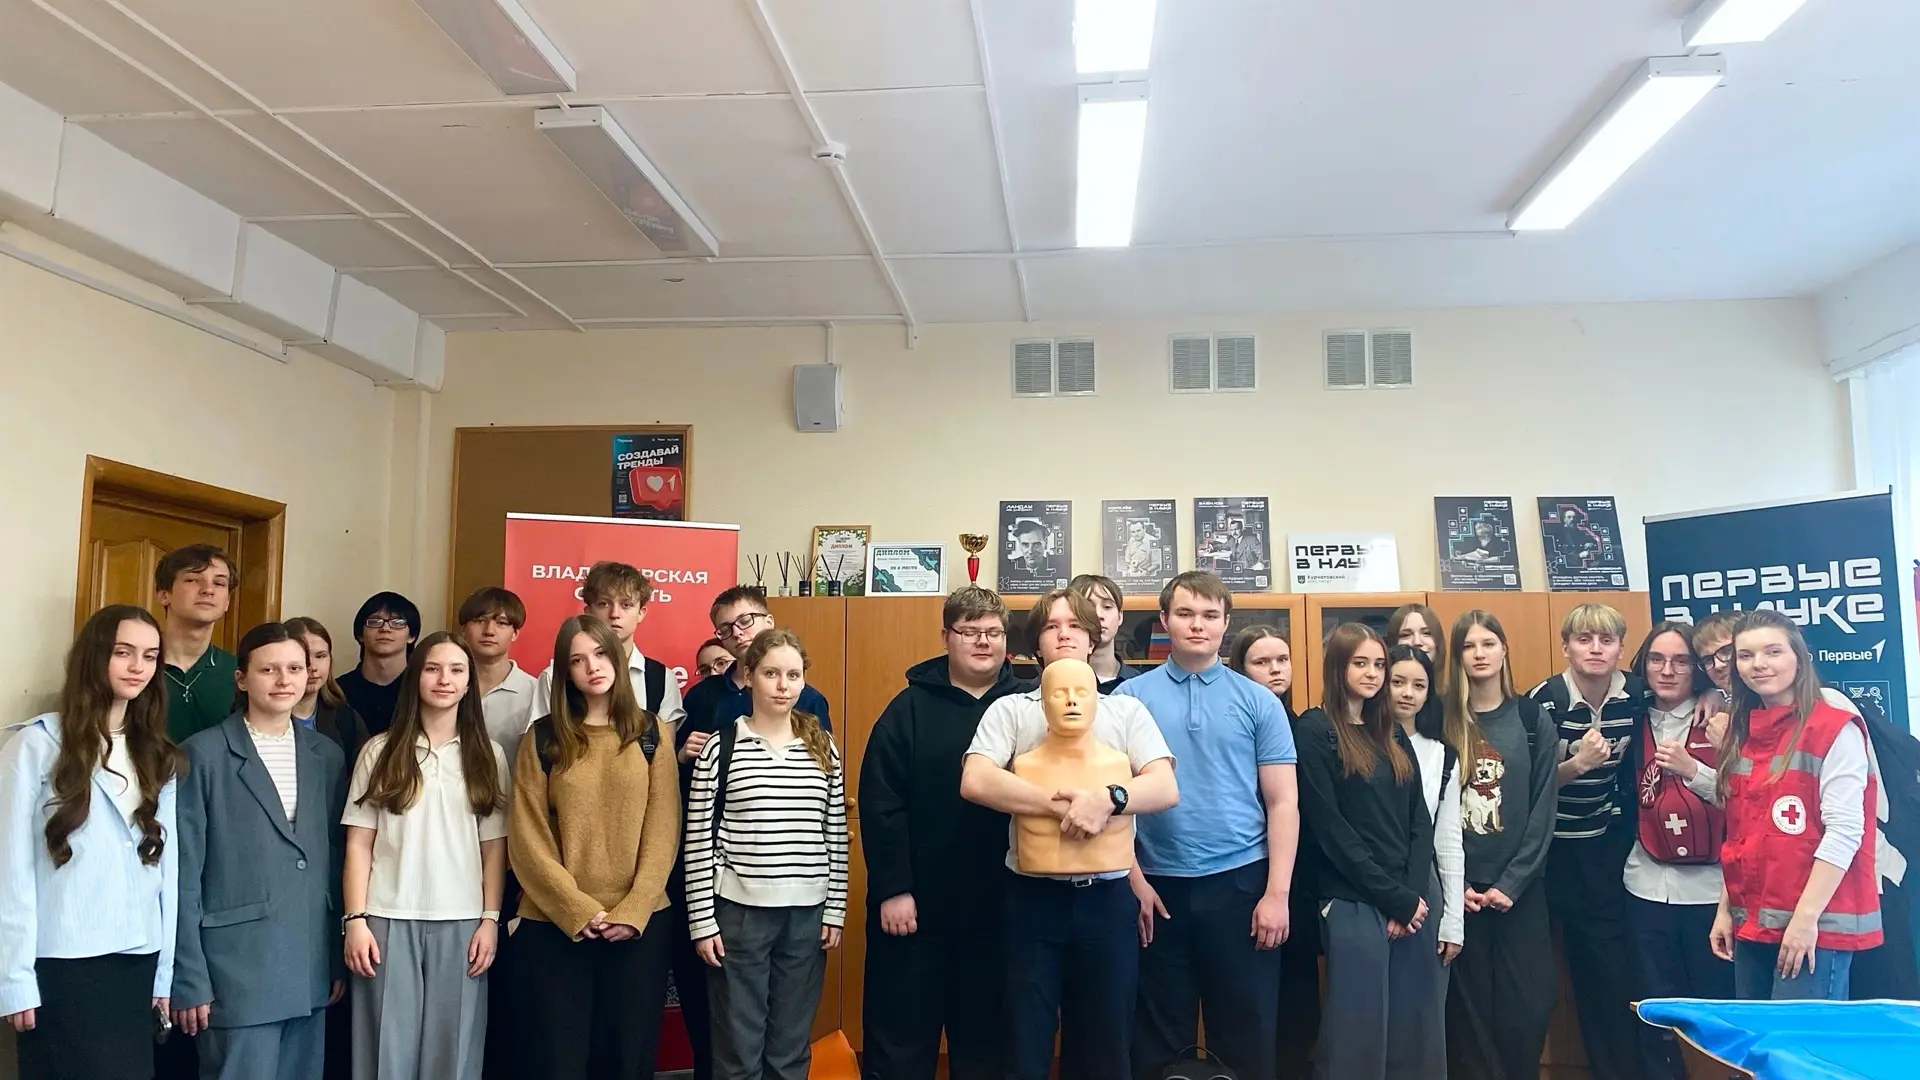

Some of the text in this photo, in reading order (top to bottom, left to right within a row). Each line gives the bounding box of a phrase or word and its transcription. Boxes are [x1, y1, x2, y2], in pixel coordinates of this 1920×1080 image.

[617, 445, 679, 461] СОЗДАВАЙ
[617, 457, 664, 470] ТРЕНДЫ
[1296, 558, 1310, 569] В
[532, 564, 708, 584] ВЛАДРСКАЯ
[1818, 649, 1873, 665] Первые
